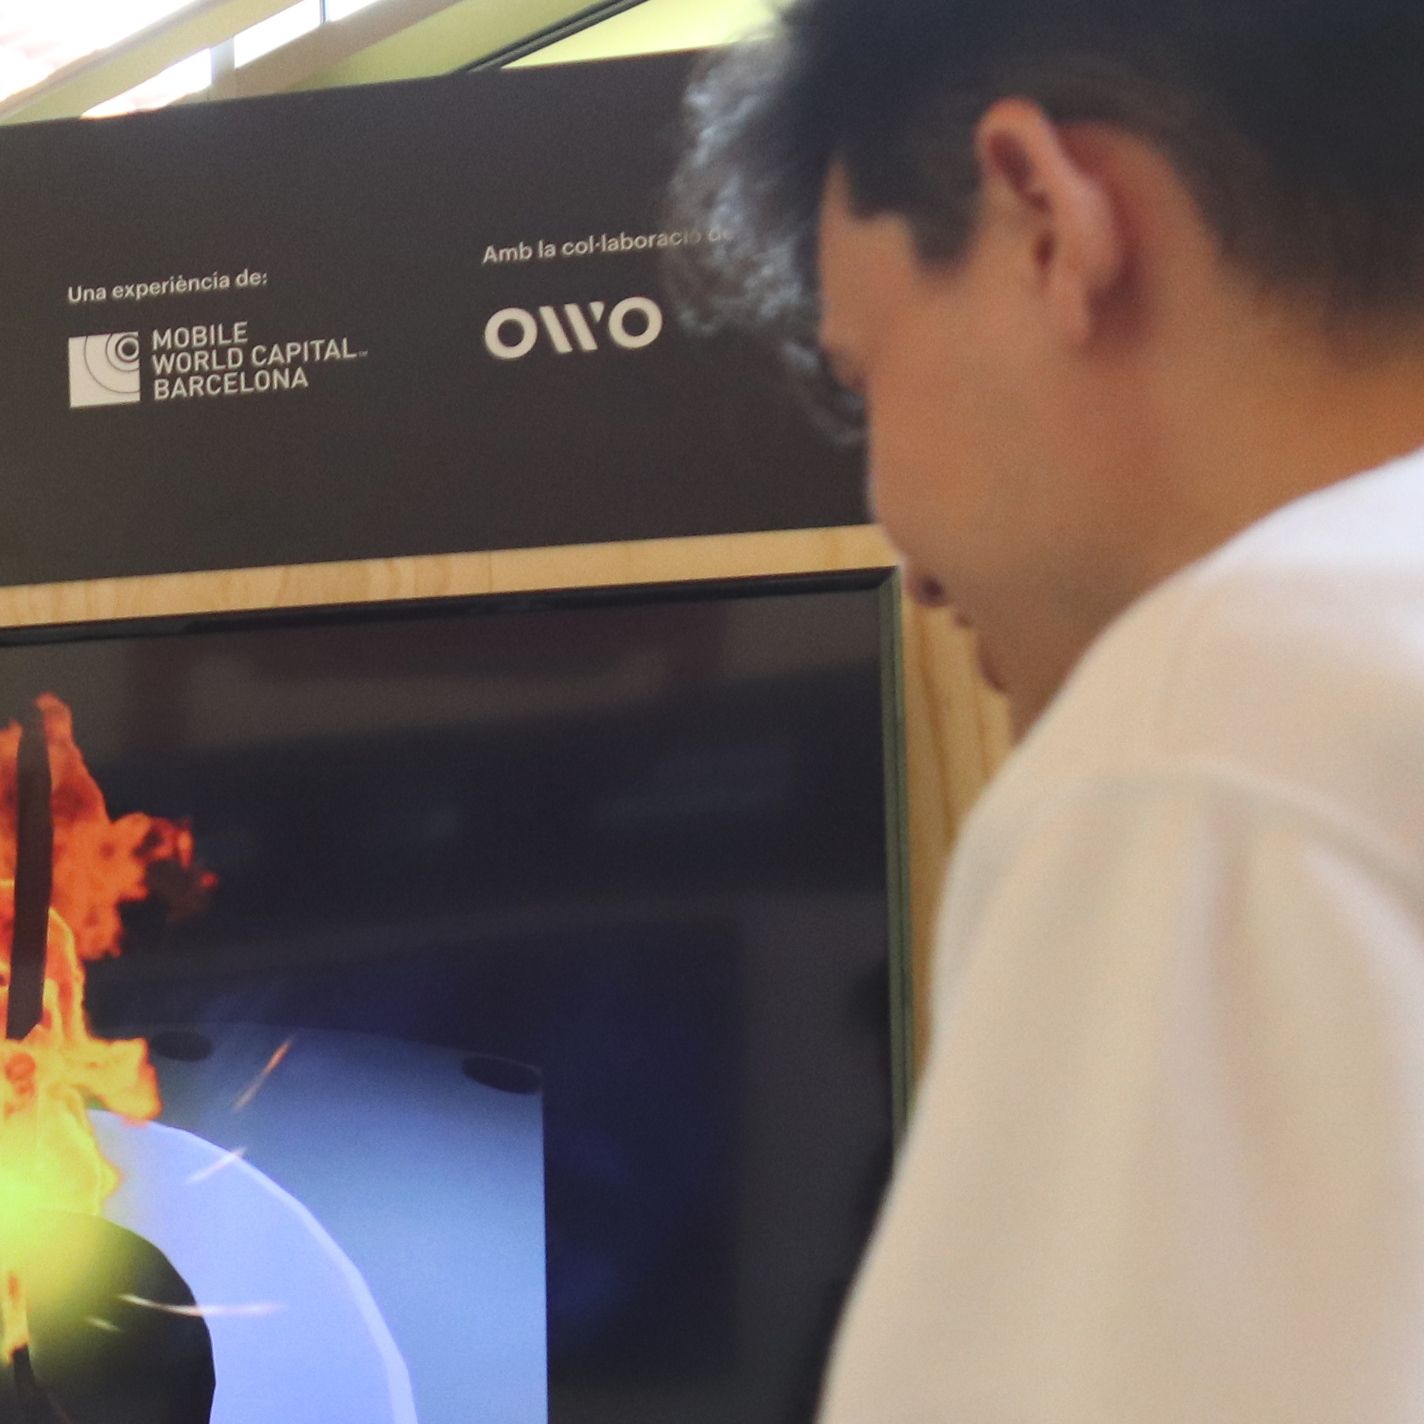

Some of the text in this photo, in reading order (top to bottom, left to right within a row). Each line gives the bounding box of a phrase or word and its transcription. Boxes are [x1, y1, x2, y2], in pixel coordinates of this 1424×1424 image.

[482, 242, 533, 265] Amb
[538, 239, 557, 258] la
[68, 267, 268, 304] Una experiència de:
[152, 321, 249, 350] MOBILE
[152, 338, 358, 375] WORLD CAPITAL
[153, 366, 309, 401] BARCELONA
